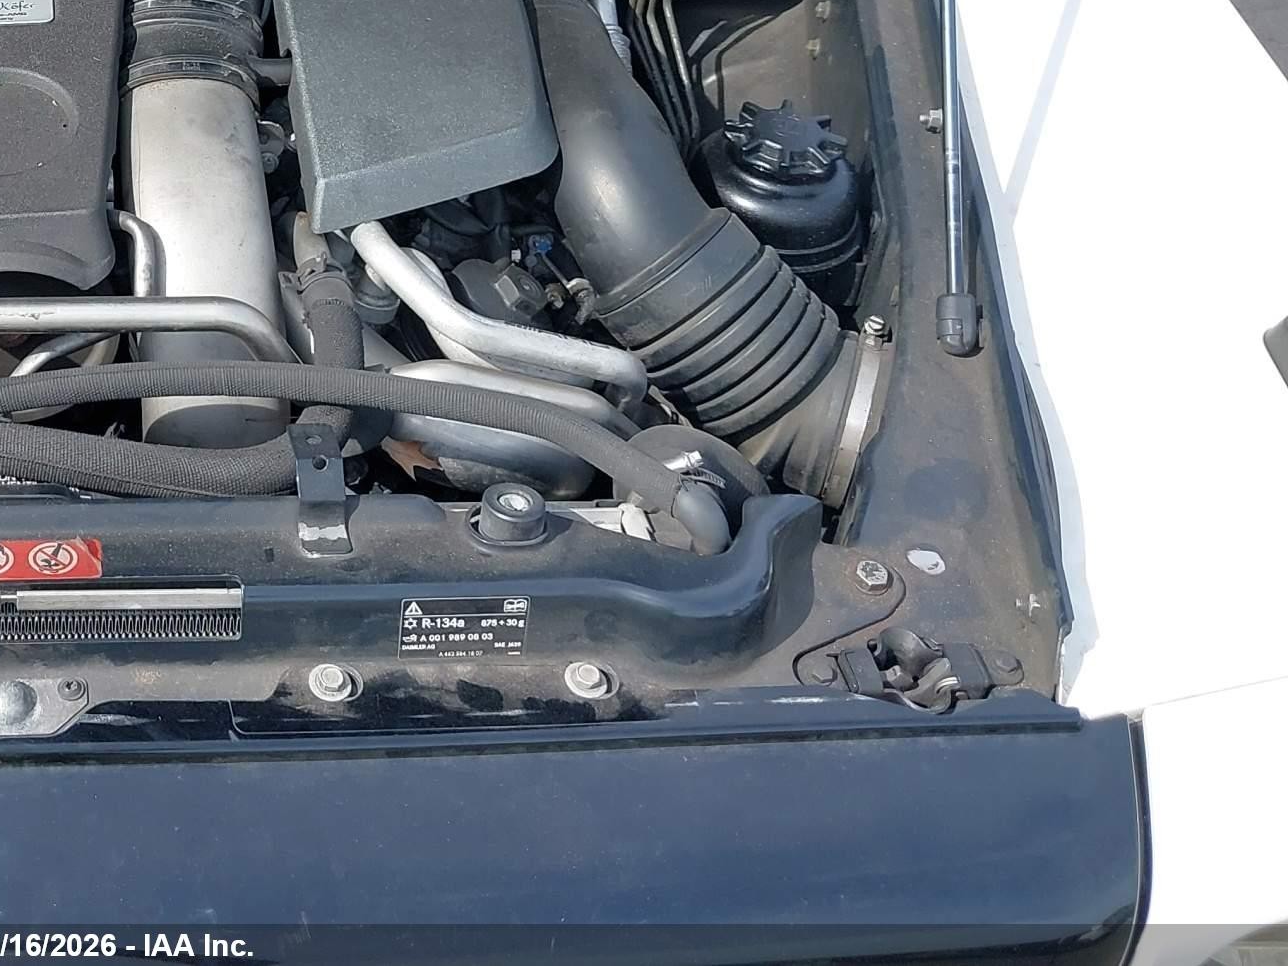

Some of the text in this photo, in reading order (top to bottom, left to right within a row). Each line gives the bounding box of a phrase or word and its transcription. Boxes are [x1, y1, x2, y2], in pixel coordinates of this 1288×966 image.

[421, 617, 465, 628] R-134a
[506, 618, 517, 626] 30
[518, 619, 525, 628] g
[429, 634, 445, 642] 001
[481, 633, 493, 641] 03
